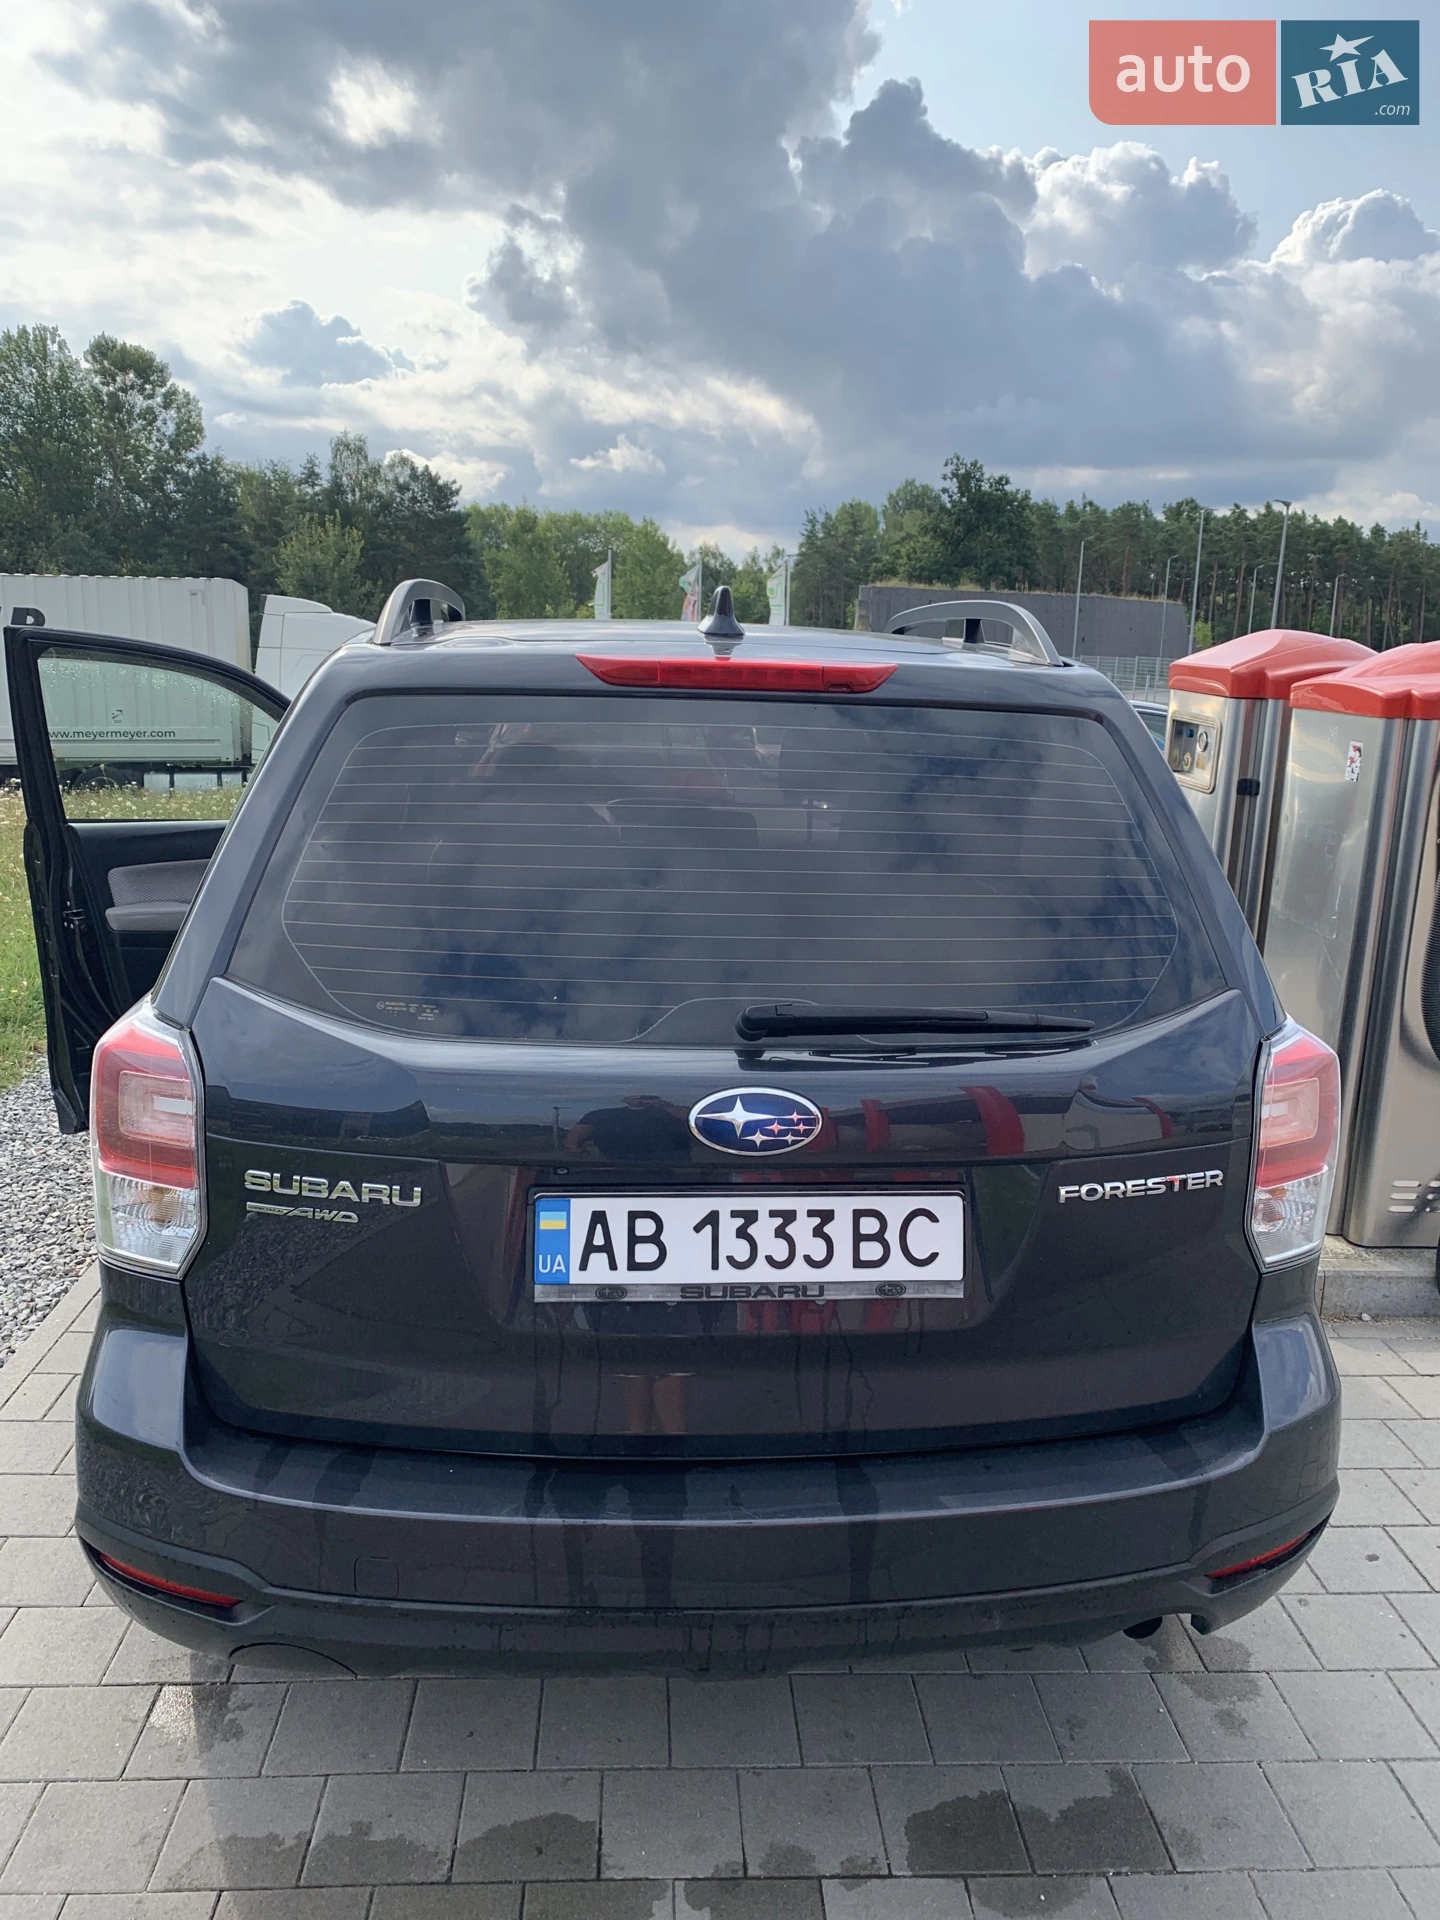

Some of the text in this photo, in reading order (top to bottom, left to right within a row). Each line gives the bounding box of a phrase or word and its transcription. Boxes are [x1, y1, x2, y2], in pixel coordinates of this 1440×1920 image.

[244, 1169, 422, 1207] SUBARU
[1058, 1169, 1224, 1203] FORESTER
[287, 1206, 359, 1223] AWD
[538, 1254, 567, 1274] UA
[680, 1284, 825, 1299] SUBARU
